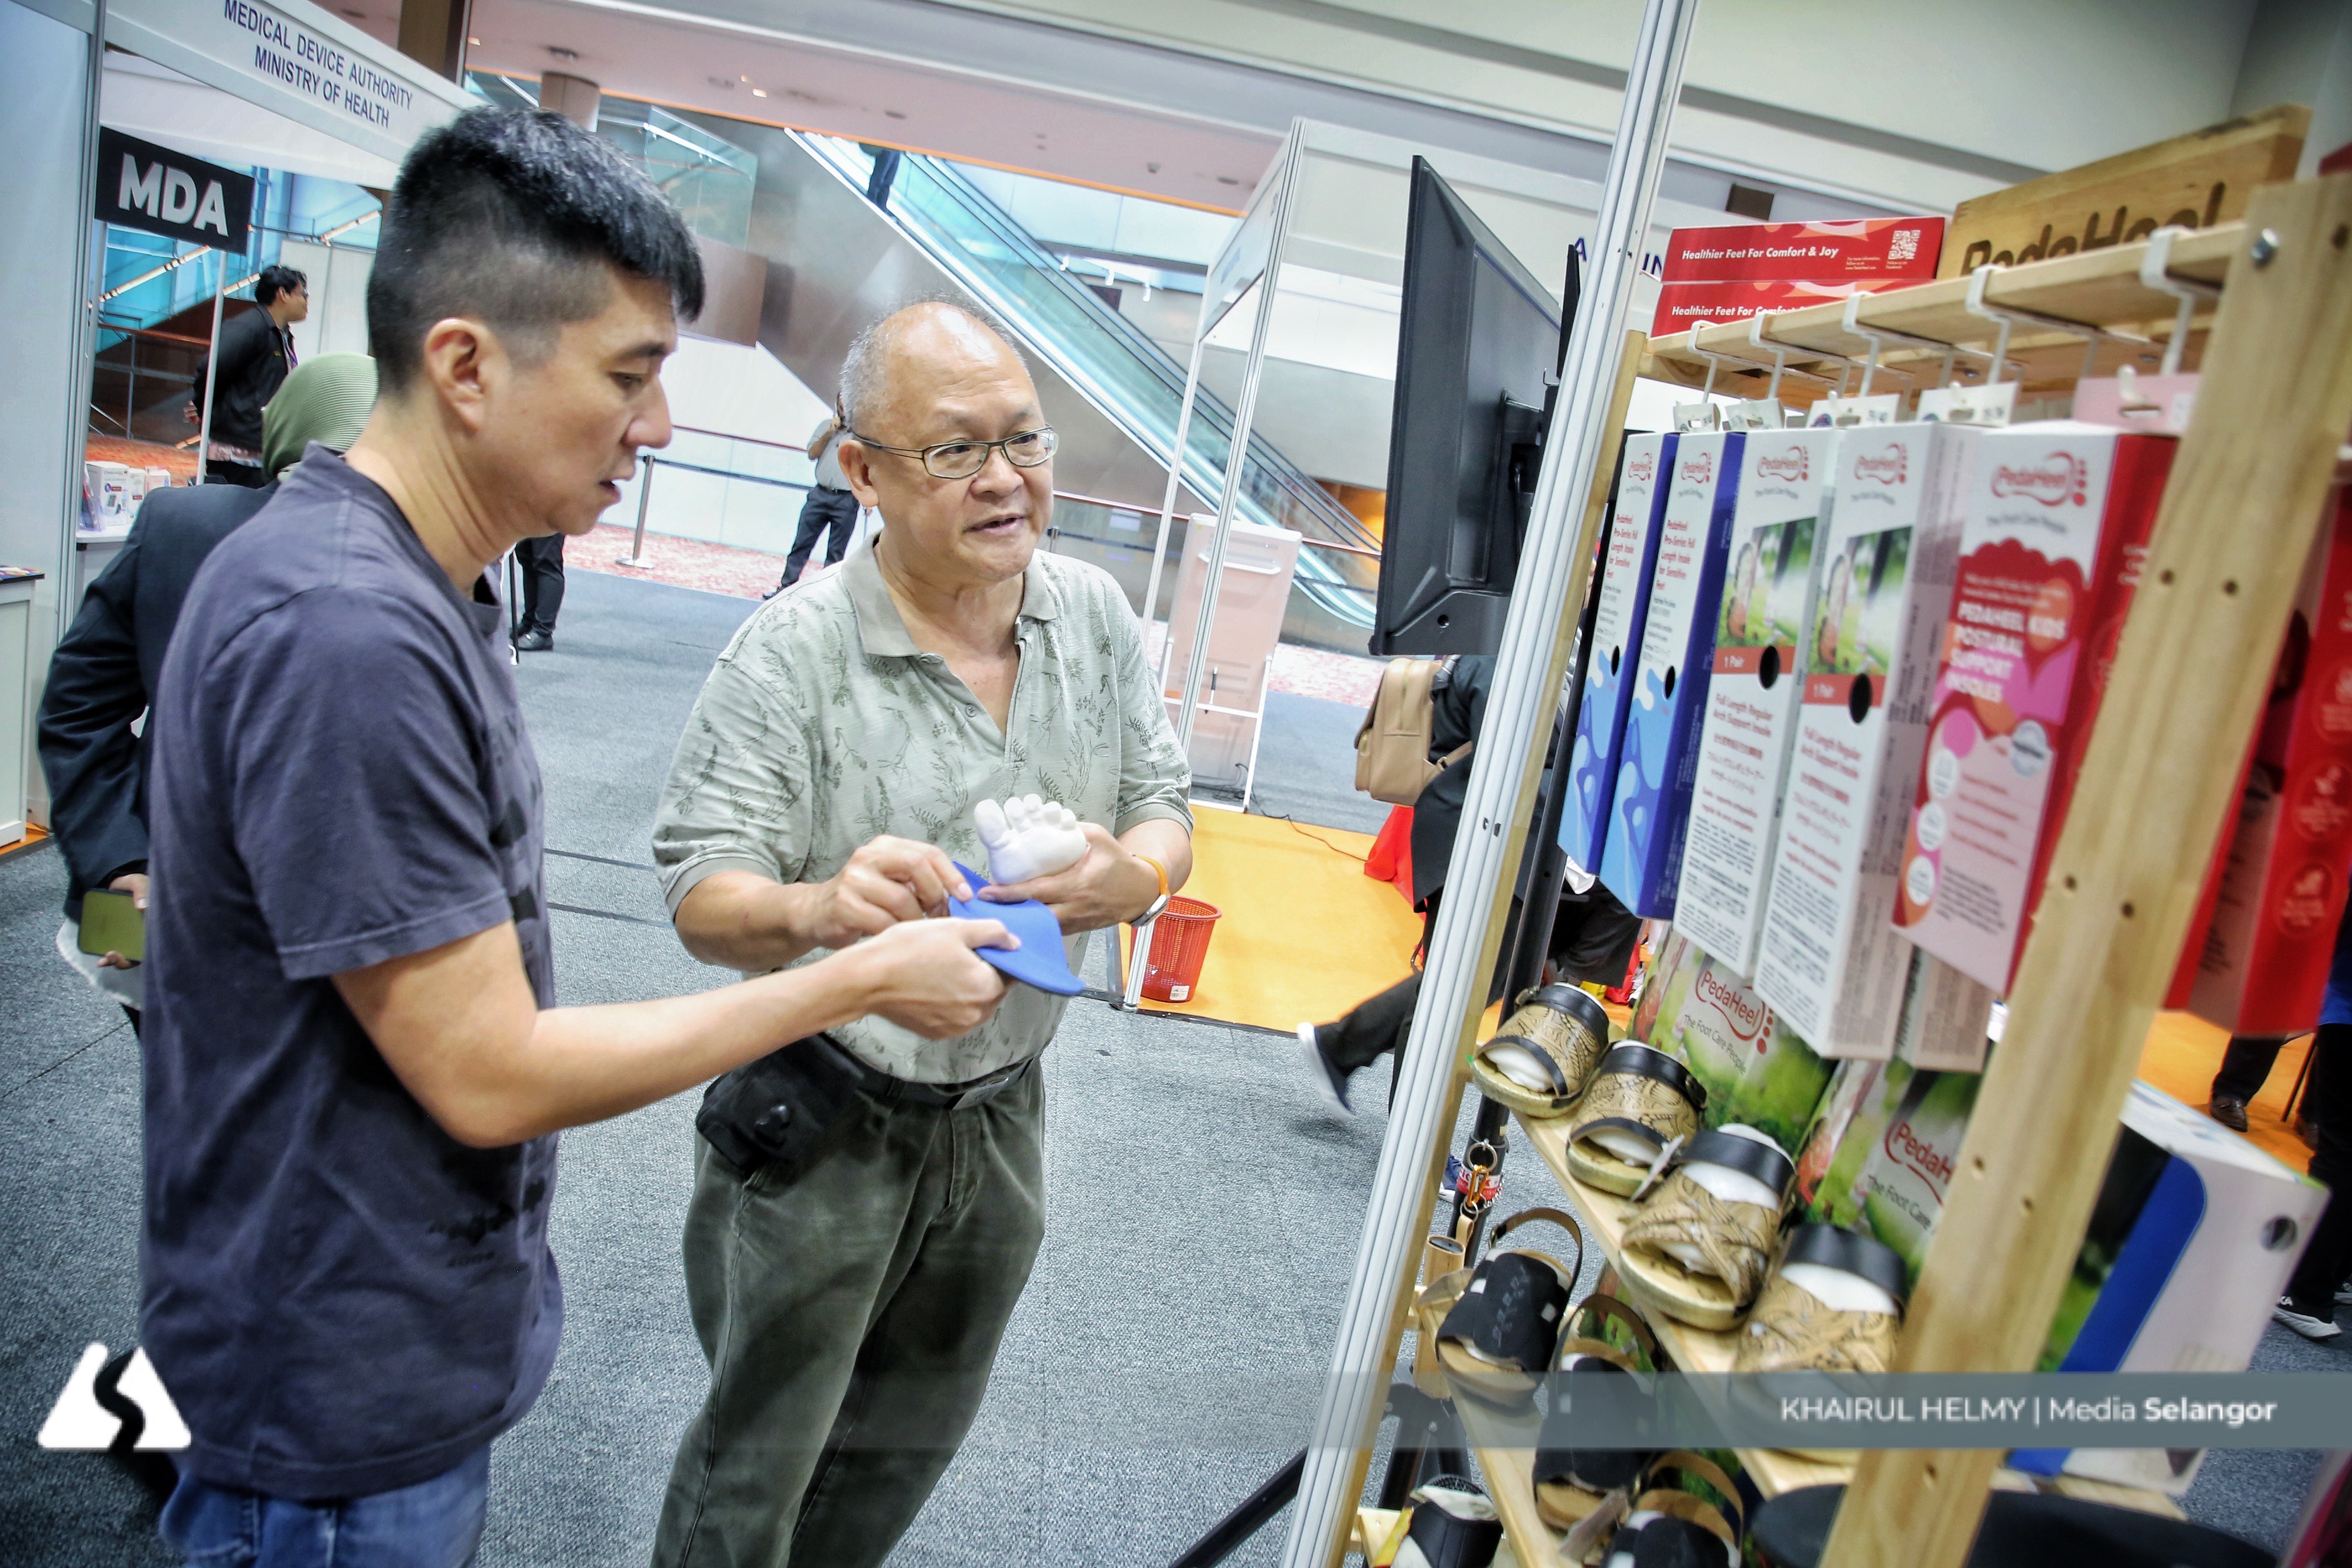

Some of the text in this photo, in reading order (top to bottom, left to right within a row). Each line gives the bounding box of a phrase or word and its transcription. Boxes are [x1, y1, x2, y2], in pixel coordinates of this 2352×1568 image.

[224, 0, 413, 111] MEDICAL DEVICE AUTHORITY
[255, 45, 390, 128] MINISTRY OF HEALTH
[118, 152, 229, 237] MDA
[1682, 247, 1839, 260] Healthier Feet For Comfort & Joy
[1672, 306, 1713, 317] Healthier
[1715, 306, 1735, 316] Feet
[1737, 306, 1753, 316] For
[1701, 971, 1760, 1027] PedaHeel
[1685, 1014, 1746, 1076] The Foot Care People
[1868, 1175, 1884, 1195] The
[1888, 1185, 1909, 1210] Foot
